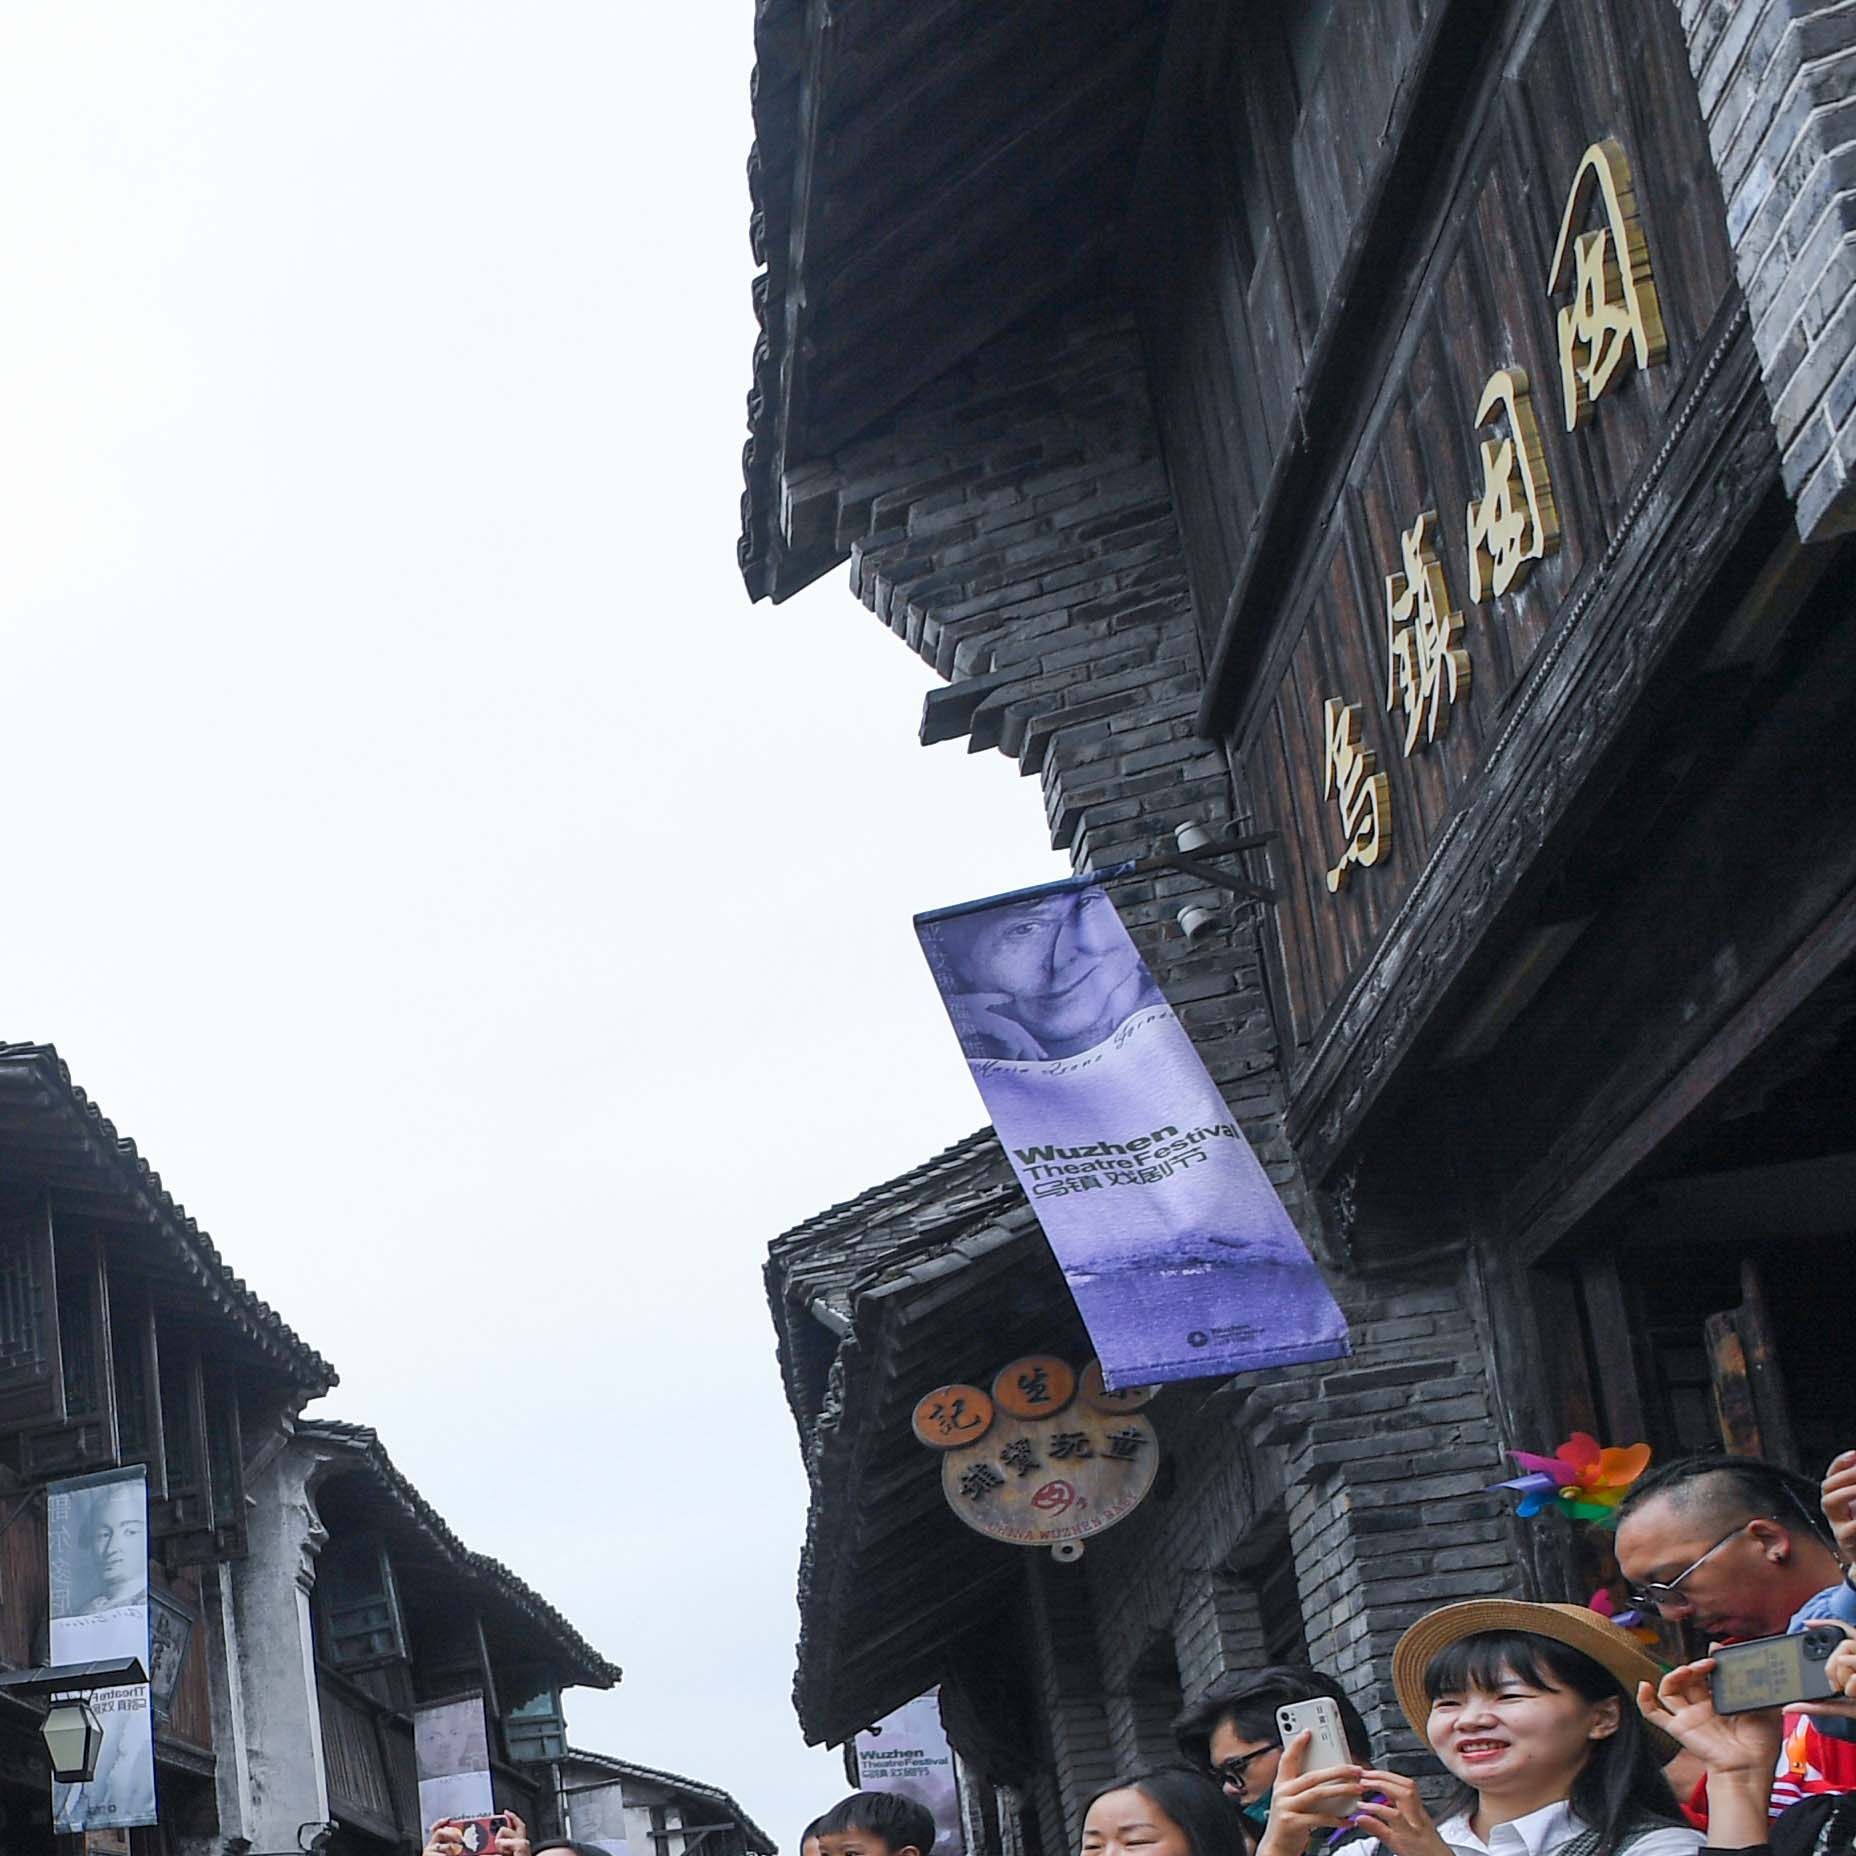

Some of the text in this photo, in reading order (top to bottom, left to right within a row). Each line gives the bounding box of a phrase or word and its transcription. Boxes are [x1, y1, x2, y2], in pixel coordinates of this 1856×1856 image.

[1015, 1125, 1178, 1166] Wuzhen
[1023, 1156, 1134, 1181] Theatre
[861, 1748, 924, 1760] Wuzhen
[863, 1756, 948, 1769] Theatre Festival
